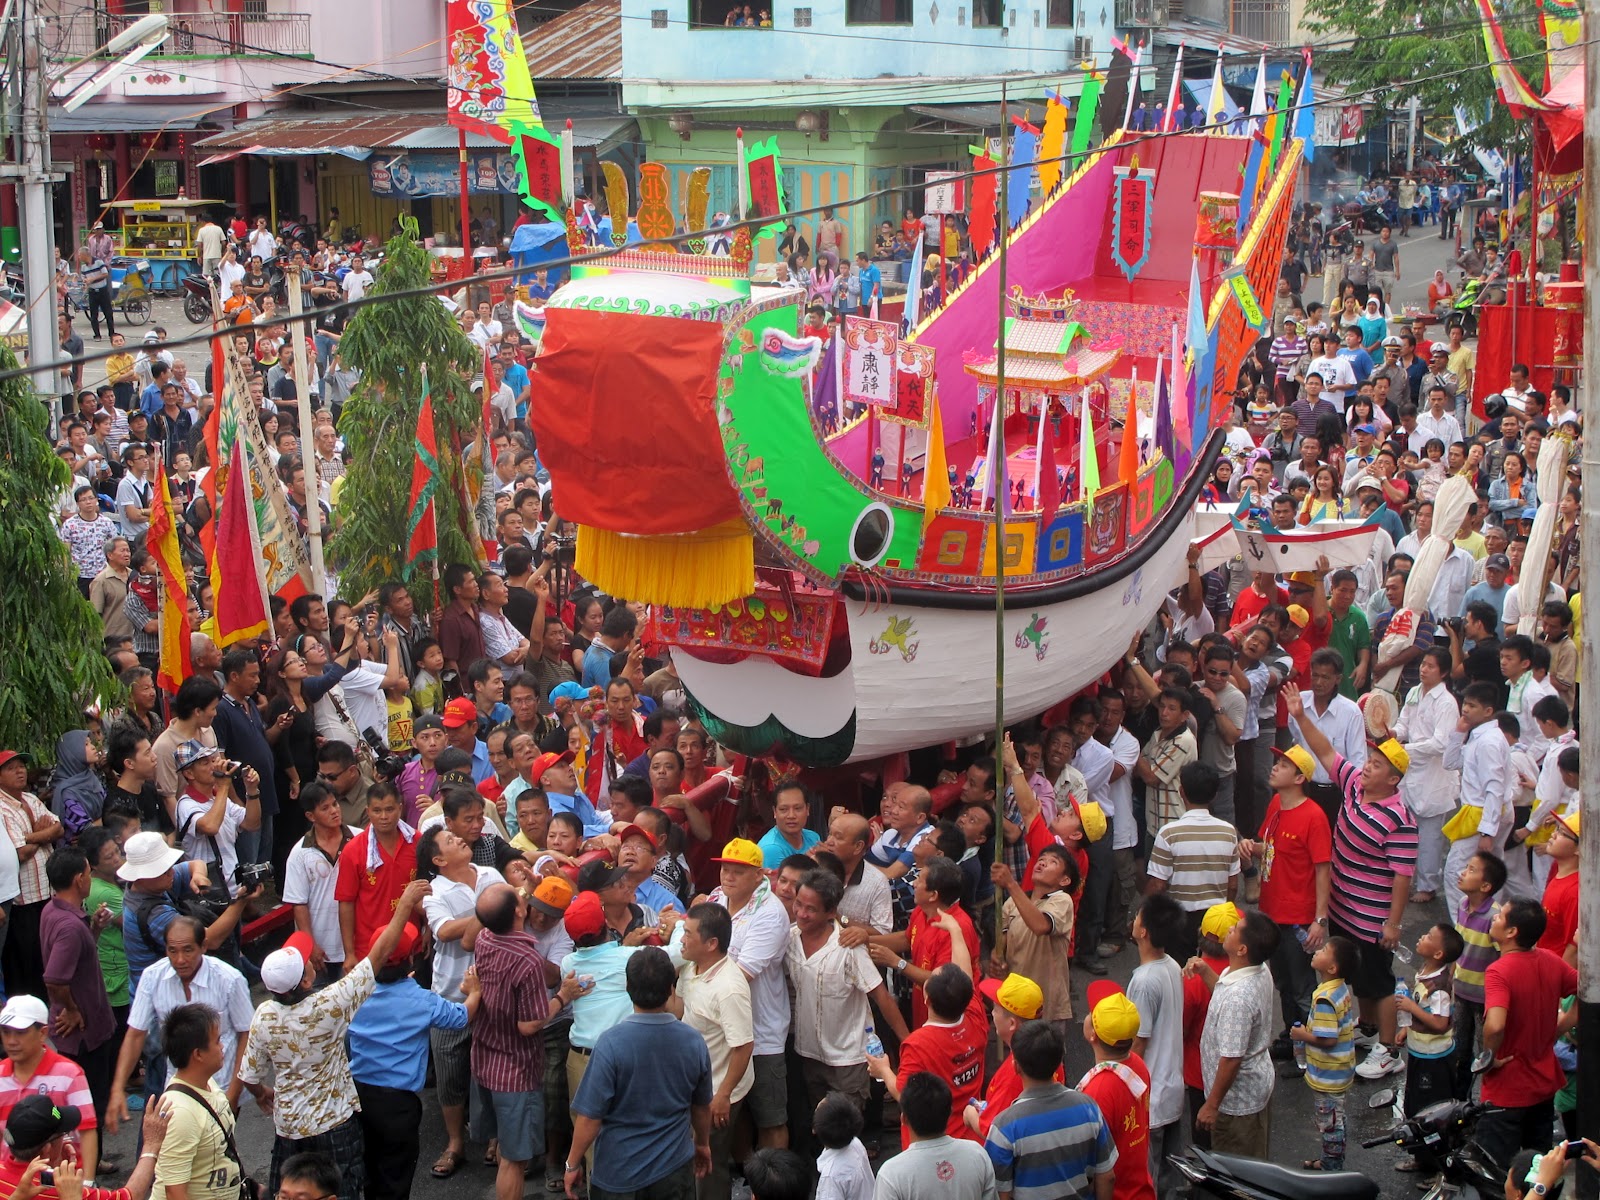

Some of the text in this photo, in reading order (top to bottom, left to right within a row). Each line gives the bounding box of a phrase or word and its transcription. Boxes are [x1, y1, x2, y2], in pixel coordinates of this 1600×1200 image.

[373, 172, 388, 180] TOP
[481, 169, 494, 177] TOP
[1125, 184, 1140, 255] 三軍司命
[862, 351, 879, 395] 肅靜
[906, 378, 922, 417] 代天
